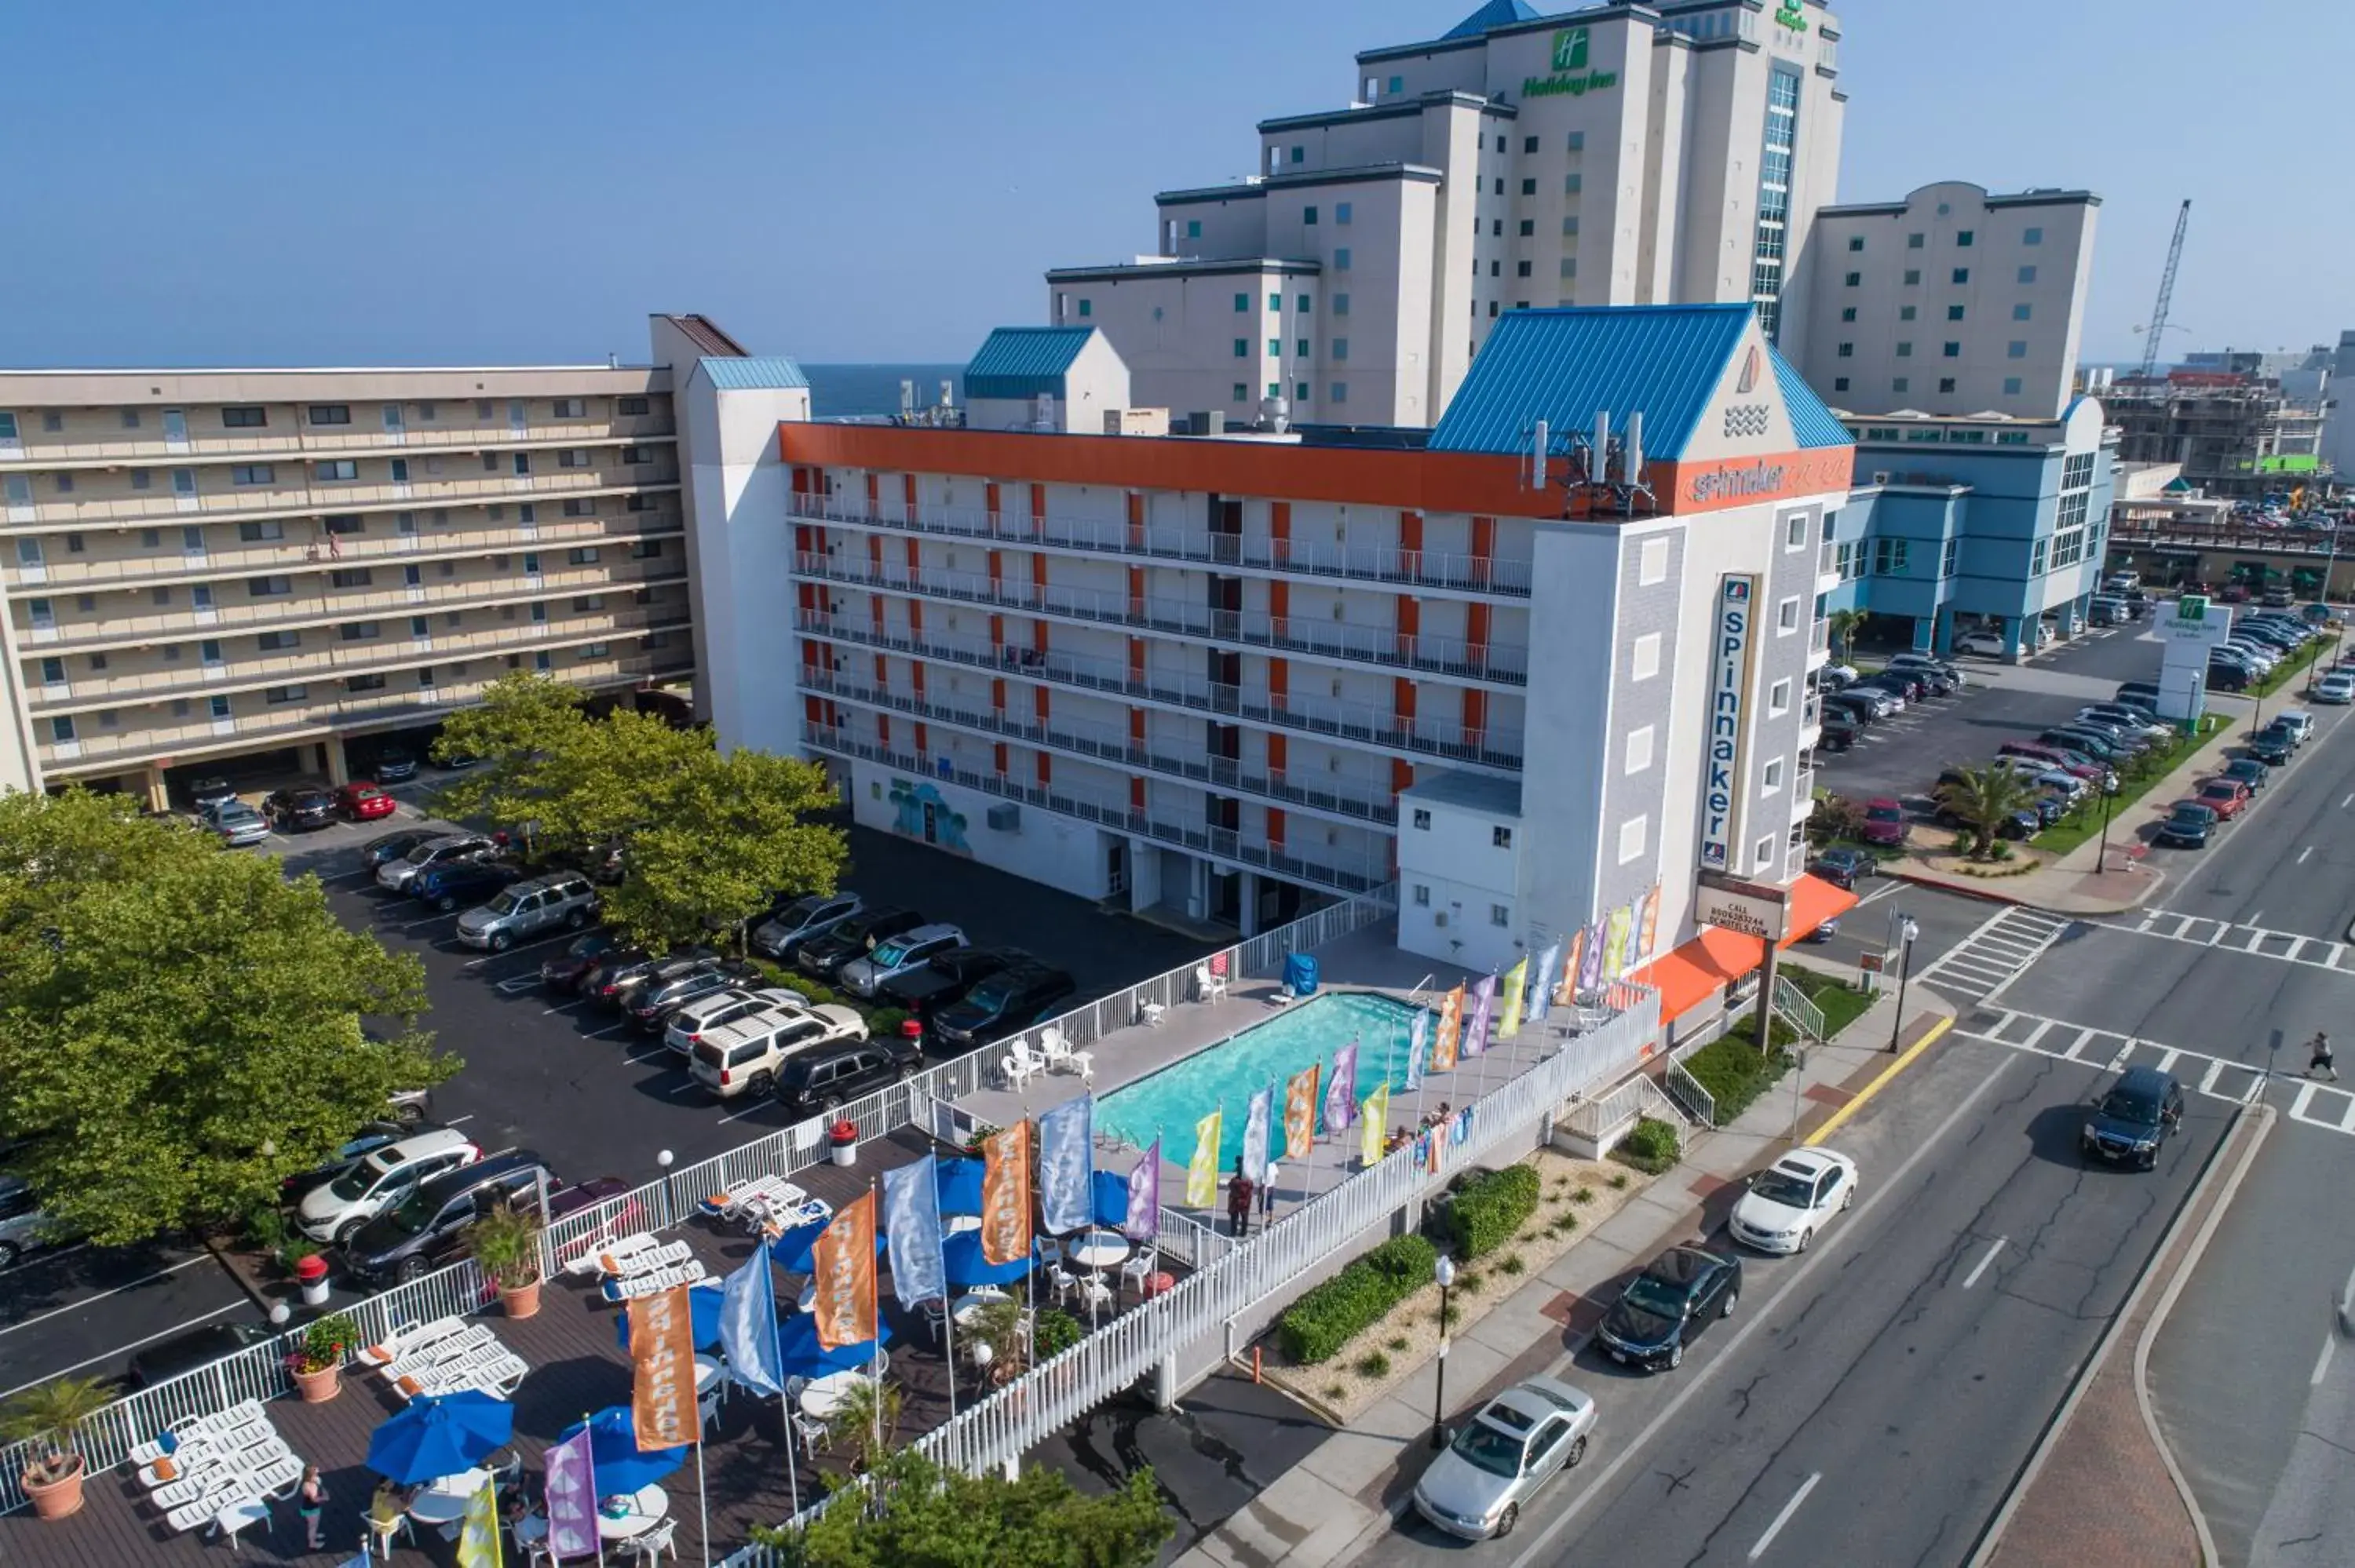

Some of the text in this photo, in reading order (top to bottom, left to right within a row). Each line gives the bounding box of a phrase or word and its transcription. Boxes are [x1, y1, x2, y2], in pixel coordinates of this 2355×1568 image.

[1521, 68, 1617, 99] Holiday Inn
[1728, 903, 1747, 914] CALL
